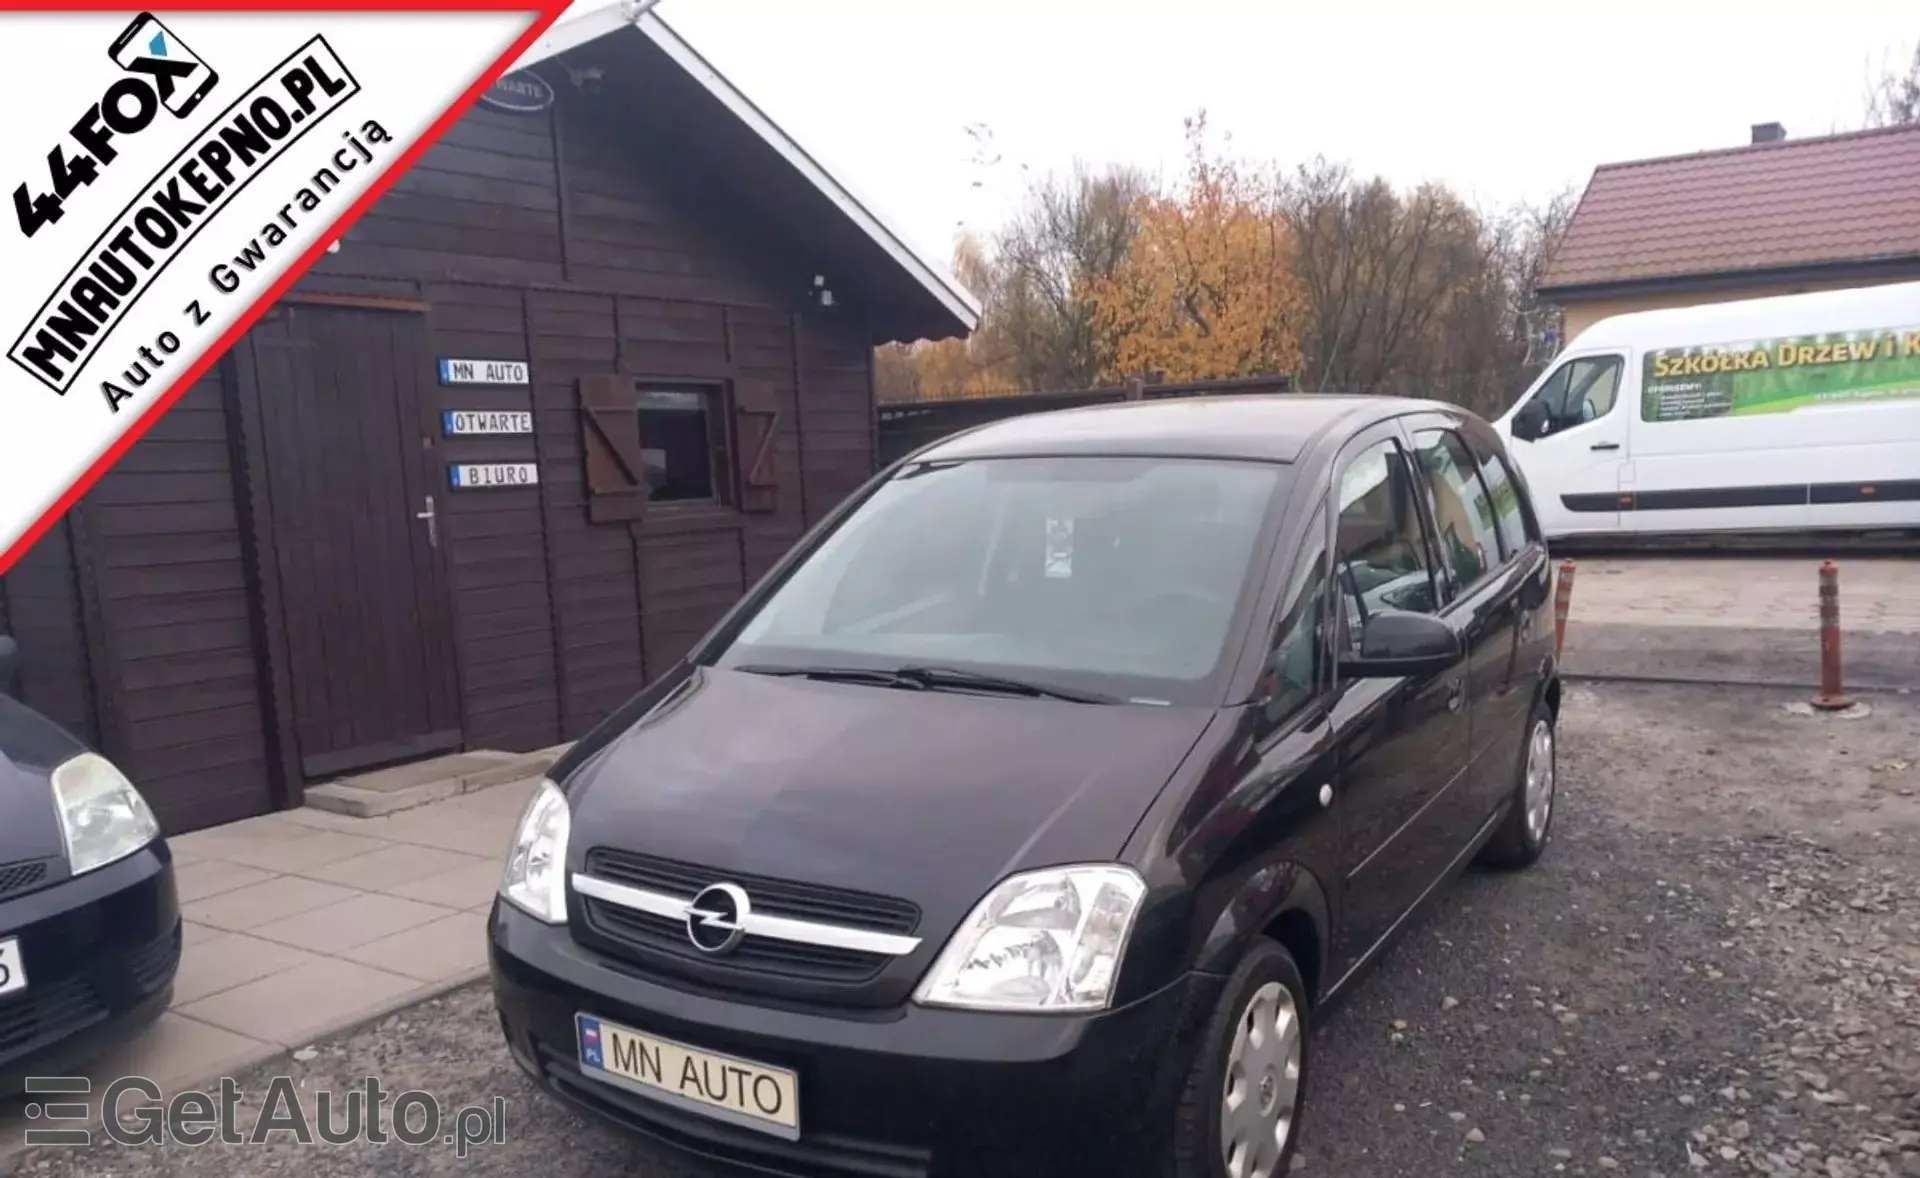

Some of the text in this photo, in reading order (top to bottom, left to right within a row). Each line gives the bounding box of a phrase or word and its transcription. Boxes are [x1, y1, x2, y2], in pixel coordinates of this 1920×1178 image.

[1777, 341, 1877, 367] DRZEW
[453, 362, 524, 381] MN AUTO
[455, 413, 531, 432] OTWARTE
[468, 466, 528, 485] BIURO
[612, 1032, 783, 1115] MN AUTO
